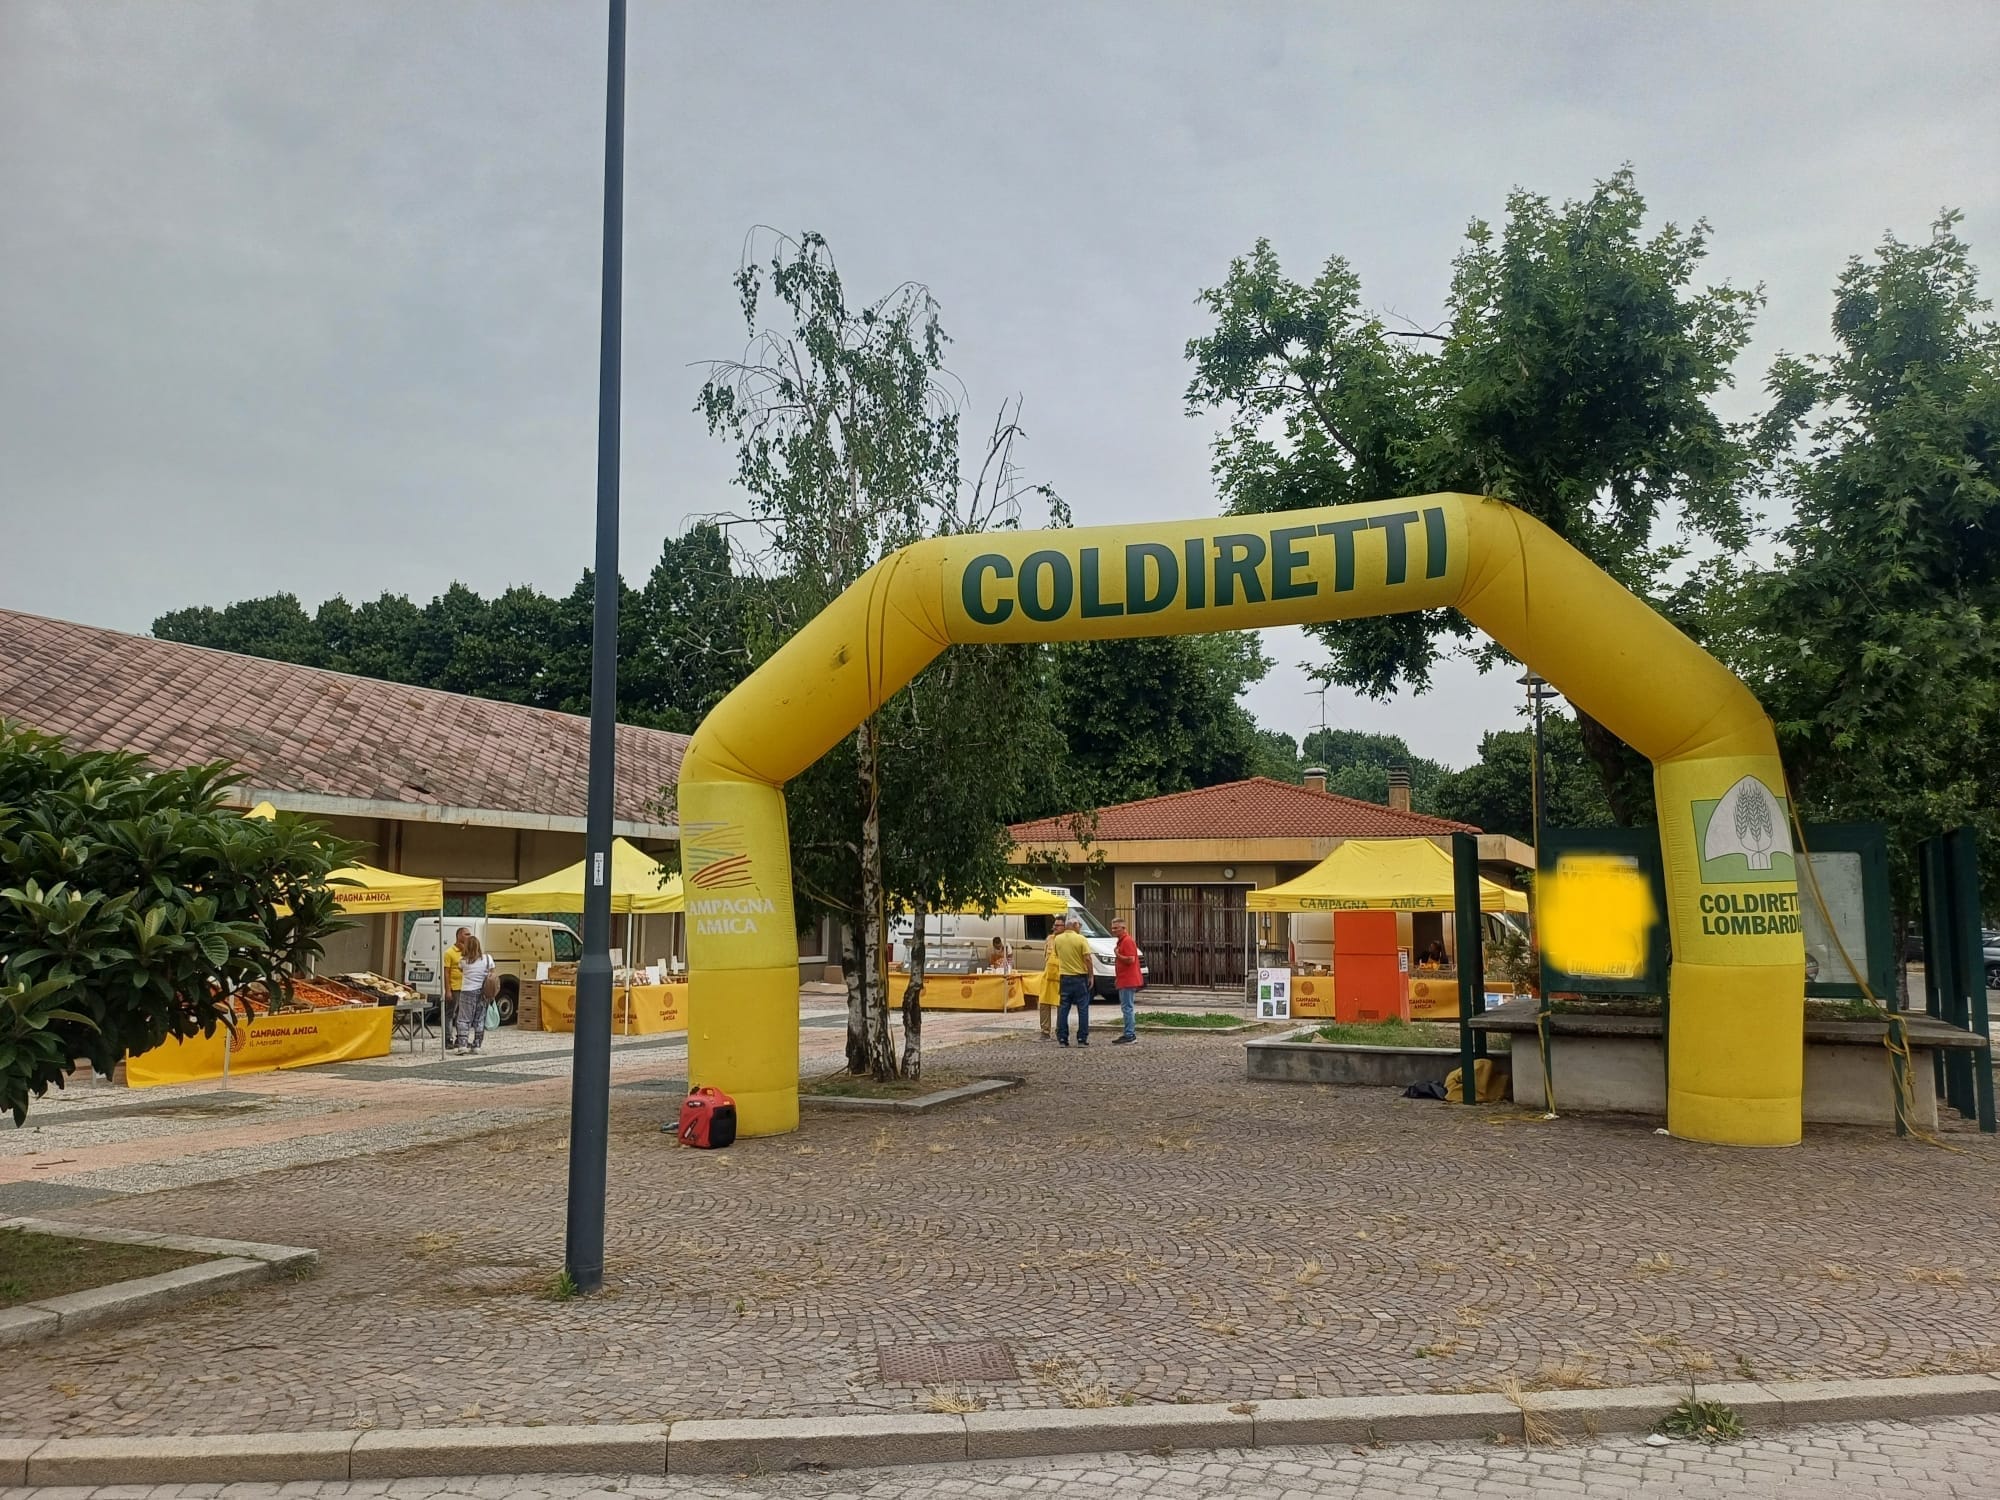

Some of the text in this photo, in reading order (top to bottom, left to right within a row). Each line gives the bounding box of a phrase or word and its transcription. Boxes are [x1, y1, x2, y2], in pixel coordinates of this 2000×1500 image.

[962, 507, 1448, 625] COLDIRETTI
[333, 893, 391, 903] MPAGNA AMICA
[1300, 896, 1435, 910] CAMPAGNA AMICA
[1699, 892, 1800, 914] COLDIRETT
[696, 918, 758, 935] AMICA
[1702, 914, 1802, 935] LOMBARDI
[250, 1025, 318, 1038] CAMPAGNA AMICA
